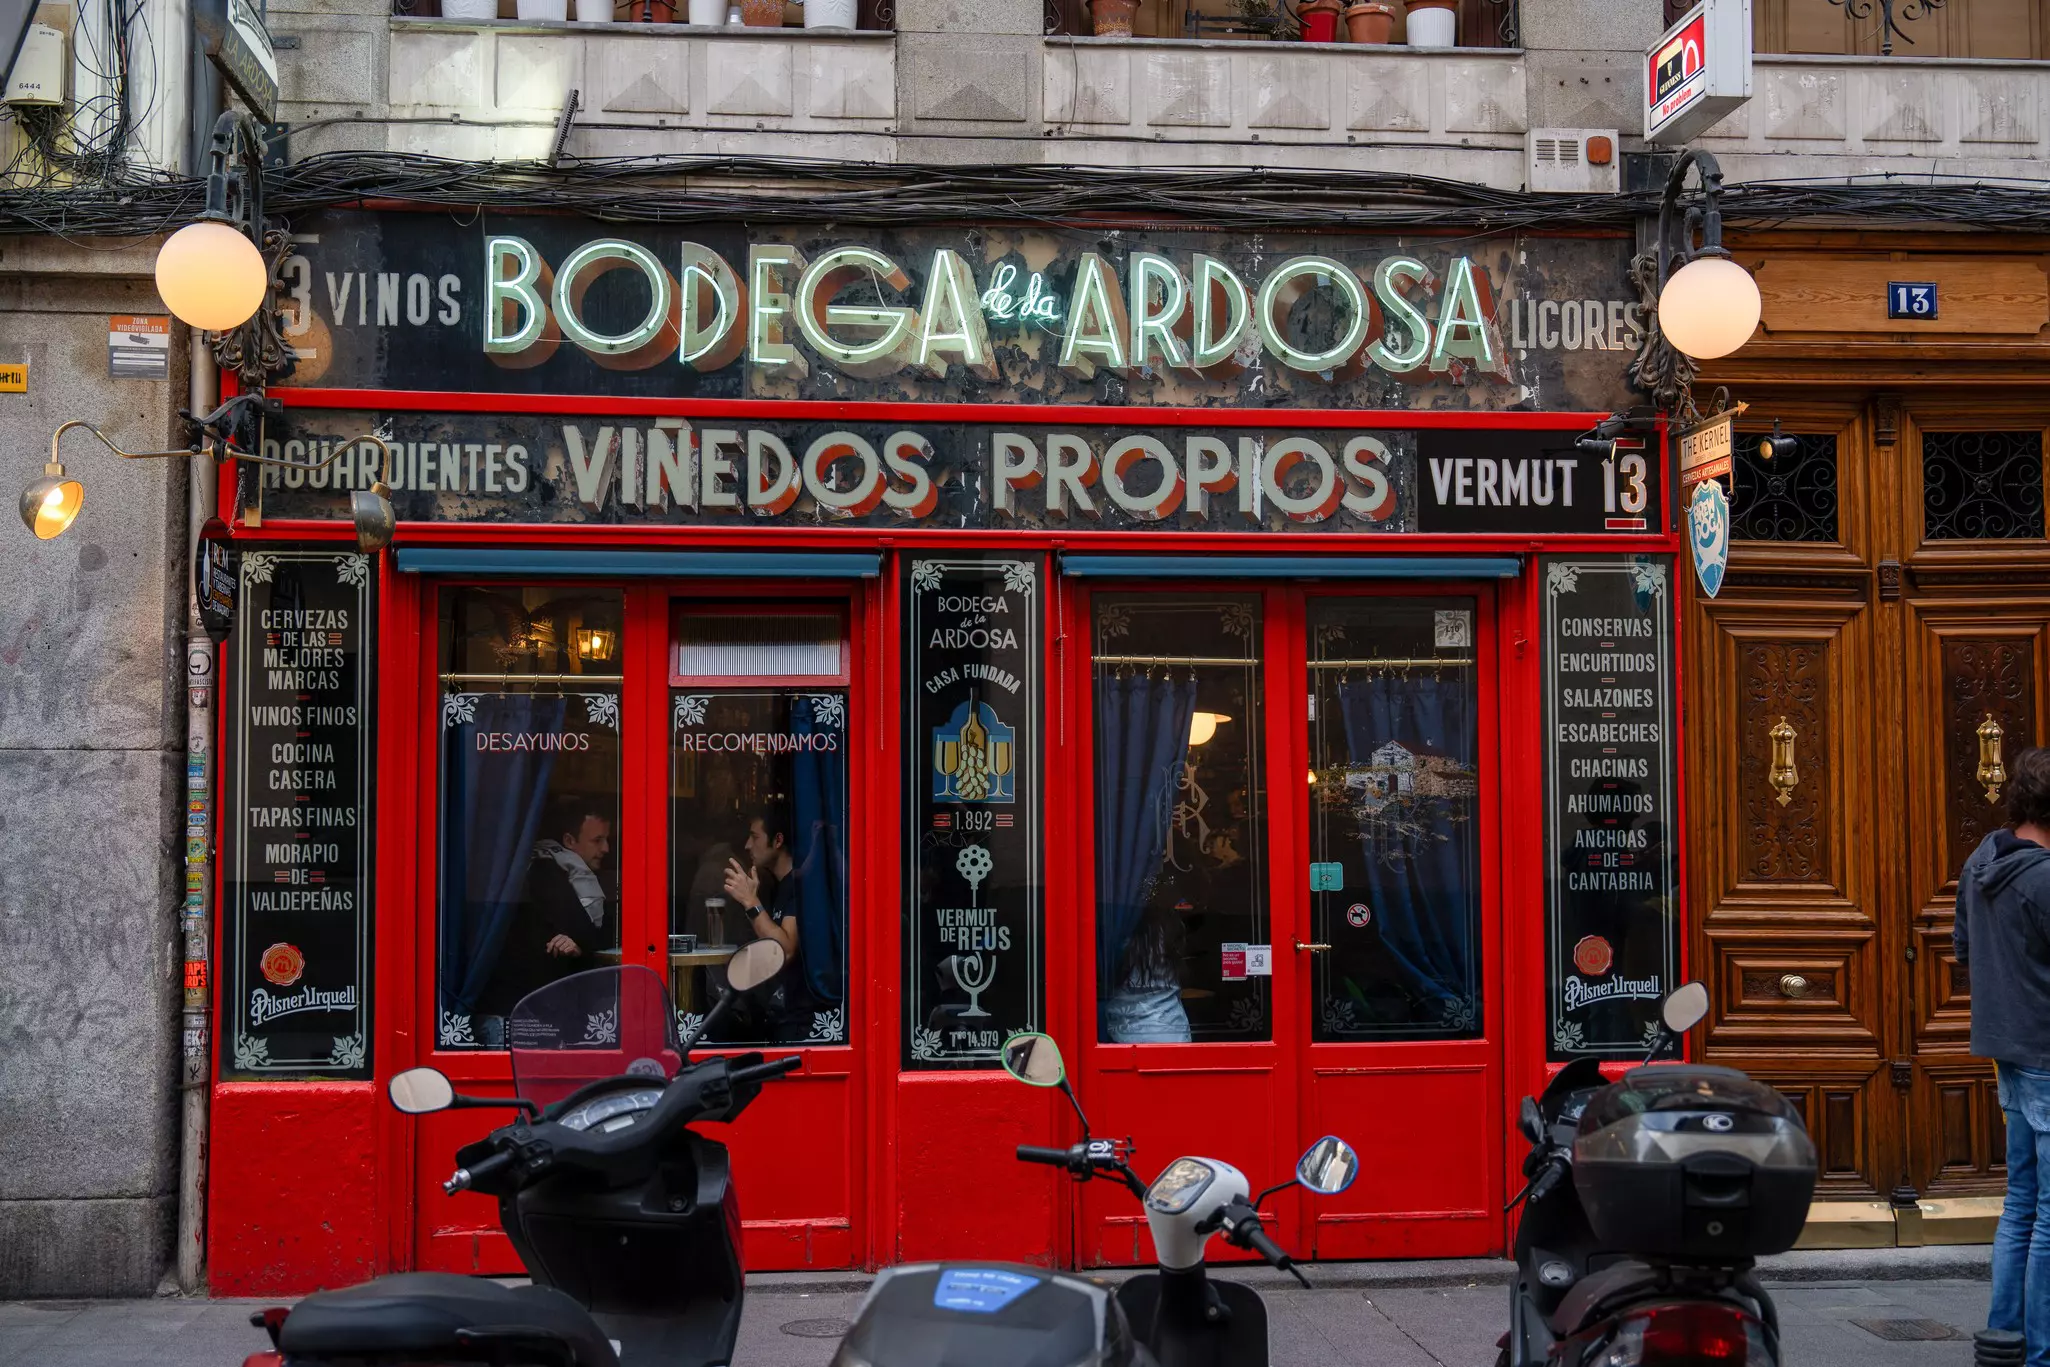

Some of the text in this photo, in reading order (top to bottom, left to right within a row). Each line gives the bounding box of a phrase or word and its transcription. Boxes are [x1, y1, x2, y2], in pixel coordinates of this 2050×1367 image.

[226, 30, 273, 103] LA ARDOSA
[1662, 88, 1692, 117] No problem
[283, 255, 461, 337] 3 VINOS
[484, 236, 986, 368] BODEGA
[1058, 251, 1494, 374] ARDOSA
[1898, 288, 1929, 313] 13
[117, 324, 163, 333] VIDEOVIGILADA
[132, 317, 148, 325] ZONA
[1512, 299, 1644, 351] LICORES
[1683, 436, 1697, 458] THE
[1700, 425, 1729, 452] KERNEL
[262, 438, 529, 493] AGUARDIENTES
[562, 418, 1395, 521] VIÑEDOS PROPIOS
[1429, 454, 1647, 513] VERMUT 13
[1693, 495, 1714, 522] BREW
[1695, 514, 1721, 541] DOG
[938, 596, 1009, 613] BODEGA
[261, 609, 348, 629] CERVEZAS
[960, 613, 987, 628] de la
[1561, 618, 1652, 637] CONSERVAS
[283, 631, 326, 647] DE LAS
[929, 629, 1018, 649] ARDOSA
[263, 648, 344, 668] MEJORES
[1560, 653, 1655, 672] ENCURTIDOS
[268, 671, 339, 690] MARCAS
[925, 664, 1021, 695] CASA FUNDADA
[1563, 688, 1653, 708] SALAZONES
[252, 706, 357, 726] VINOS FINOS
[476, 732, 589, 752] DESAYUNOS
[683, 732, 838, 752] RECOMENDAMOS
[1559, 723, 1658, 742] ESCABECHES
[271, 743, 334, 763] COCINA
[1571, 759, 1648, 778] CHACINAS
[269, 770, 336, 790] CASERA
[1568, 794, 1653, 813] AHUMADOS
[250, 807, 356, 827] TAPAS FINAS
[955, 811, 992, 831] 1.892
[1575, 829, 1647, 848] ANCHOAS
[265, 843, 338, 864] MORAPIO
[1604, 852, 1619, 867] DE
[291, 869, 309, 885] DE
[1569, 872, 1653, 891] CANTABRIA
[252, 887, 353, 911] VALDEPEÑAS
[937, 908, 997, 927] VERMUT
[941, 925, 1011, 951] DE REUS
[1564, 973, 1659, 1011] Pilsner Urquell
[251, 985, 356, 1027] Pilsner Urquell
[967, 1030, 999, 1047] 14.979
